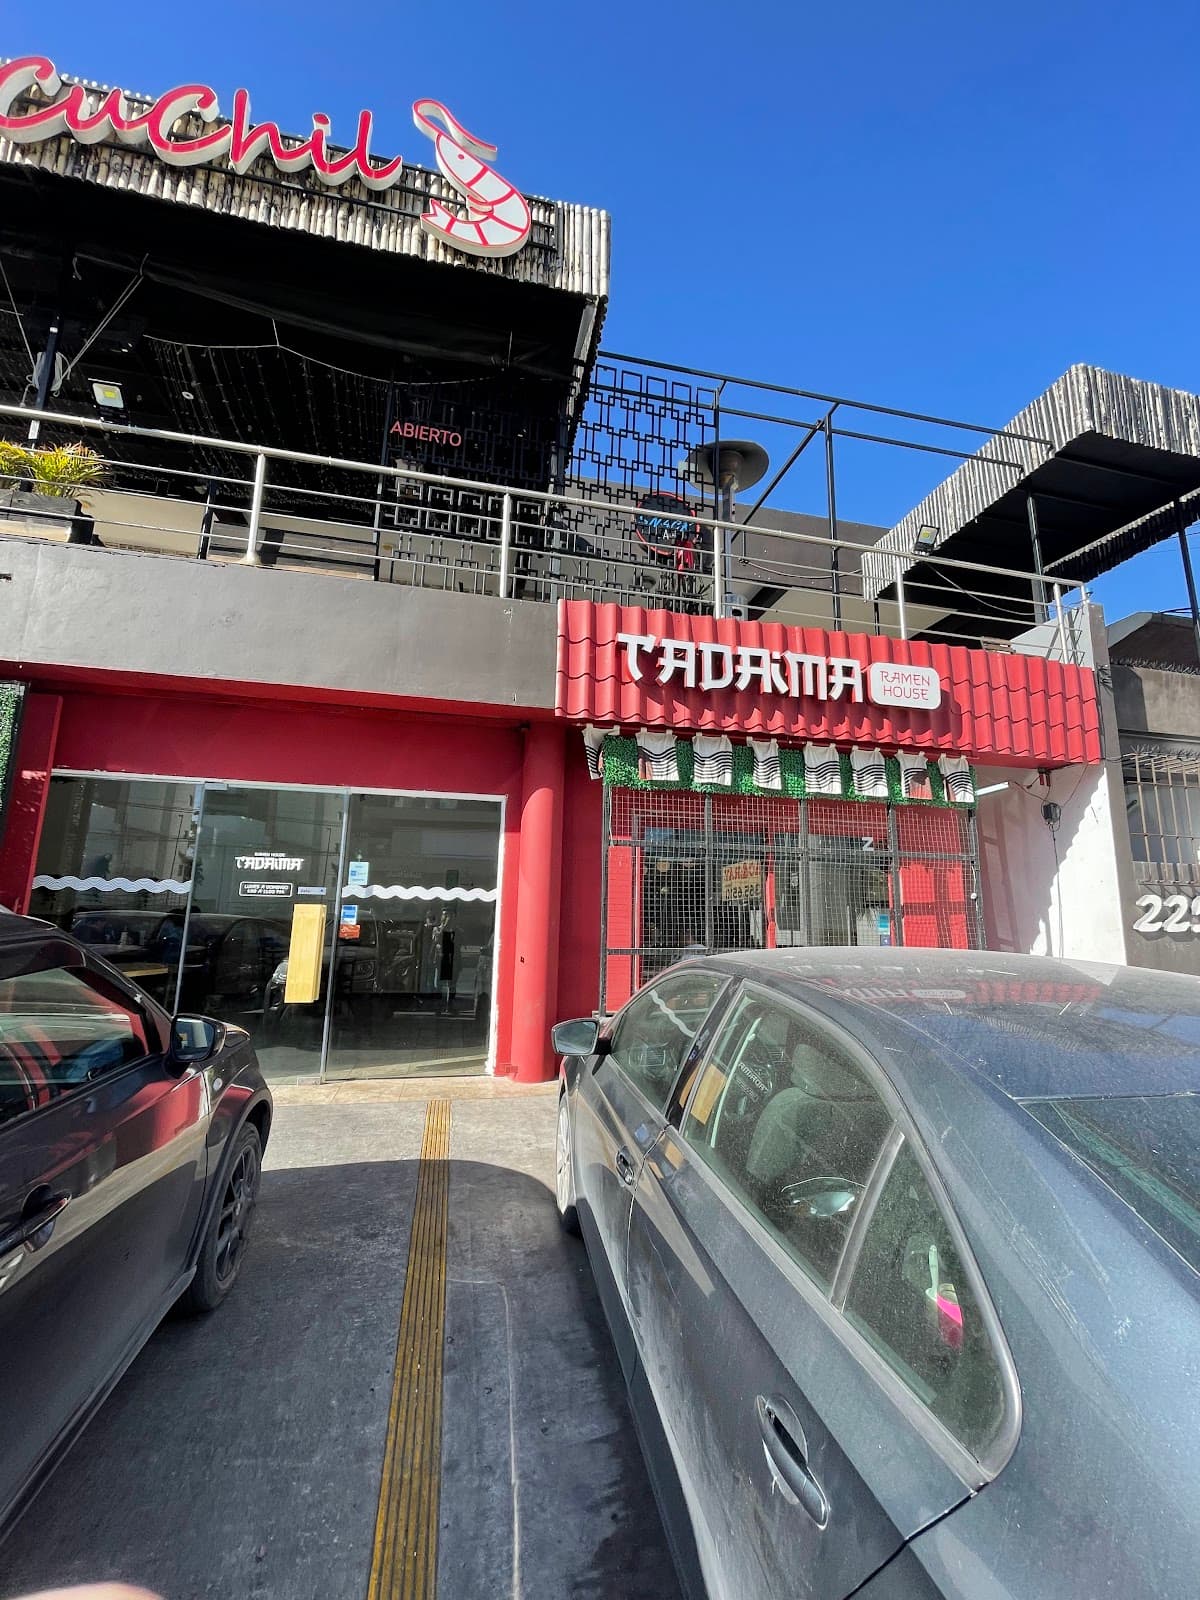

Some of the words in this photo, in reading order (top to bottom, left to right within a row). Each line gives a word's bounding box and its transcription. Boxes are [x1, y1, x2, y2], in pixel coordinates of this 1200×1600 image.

[390, 420, 462, 447] ABIERTO
[879, 670, 930, 686] RAMEN
[883, 685, 929, 701] HOUSE
